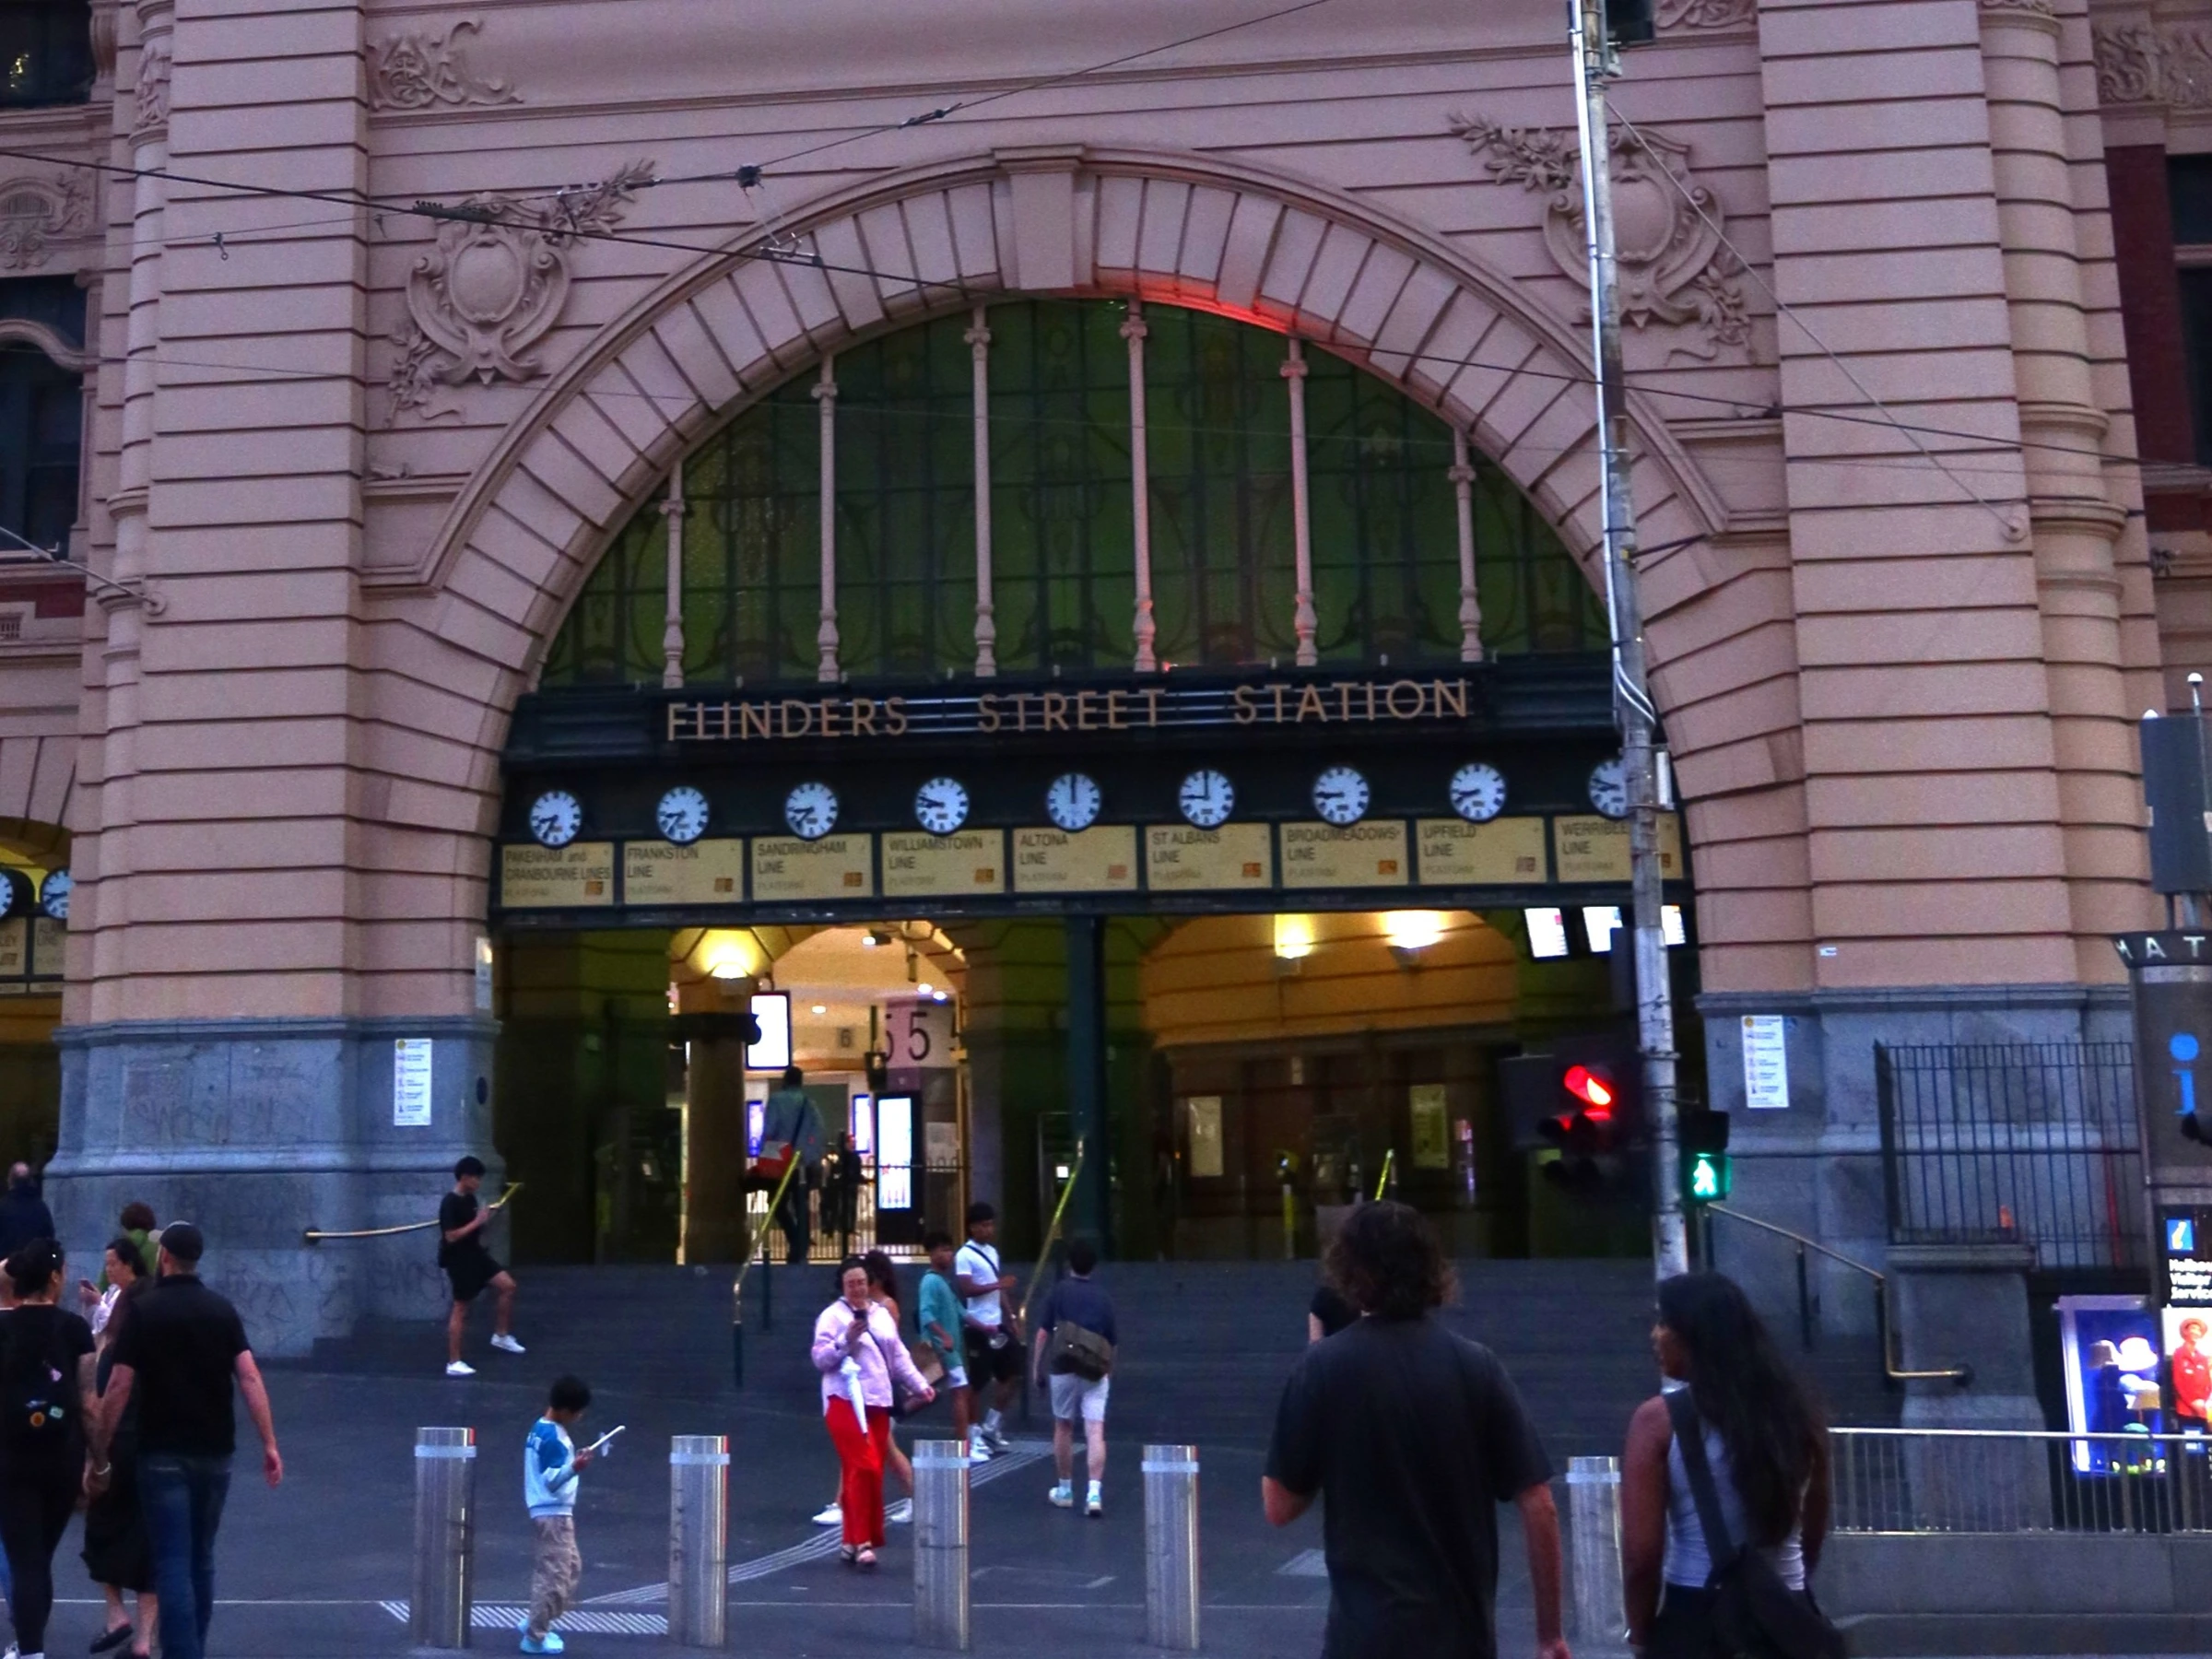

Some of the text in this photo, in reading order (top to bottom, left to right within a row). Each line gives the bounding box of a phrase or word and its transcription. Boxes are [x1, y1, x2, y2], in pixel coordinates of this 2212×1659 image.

[667, 677, 1467, 741] FLINDERS STREET STATION
[1020, 833, 1068, 847] ALTONA
[1153, 831, 1221, 845] ST ALBANS
[1287, 826, 1396, 842] BROADMEADOWS
[1423, 825, 1477, 840] UPFIELD
[758, 841, 847, 856] SANDRINGHAM
[888, 836, 983, 852] WILLIAMSTOWN
[1424, 842, 1453, 857] LINE
[1562, 841, 1592, 855] LINE
[505, 849, 588, 864] PAKENHAM and
[626, 846, 699, 861] FRANKSTON
[1019, 852, 1047, 865] LINE
[1152, 850, 1181, 865] LINE
[1287, 846, 1316, 862] LINE
[757, 860, 784, 875] LINE
[888, 856, 916, 870] LINE
[505, 865, 612, 881] CRANBOURNE LINES
[626, 865, 653, 879] LINE
[908, 1011, 931, 1061] 5
